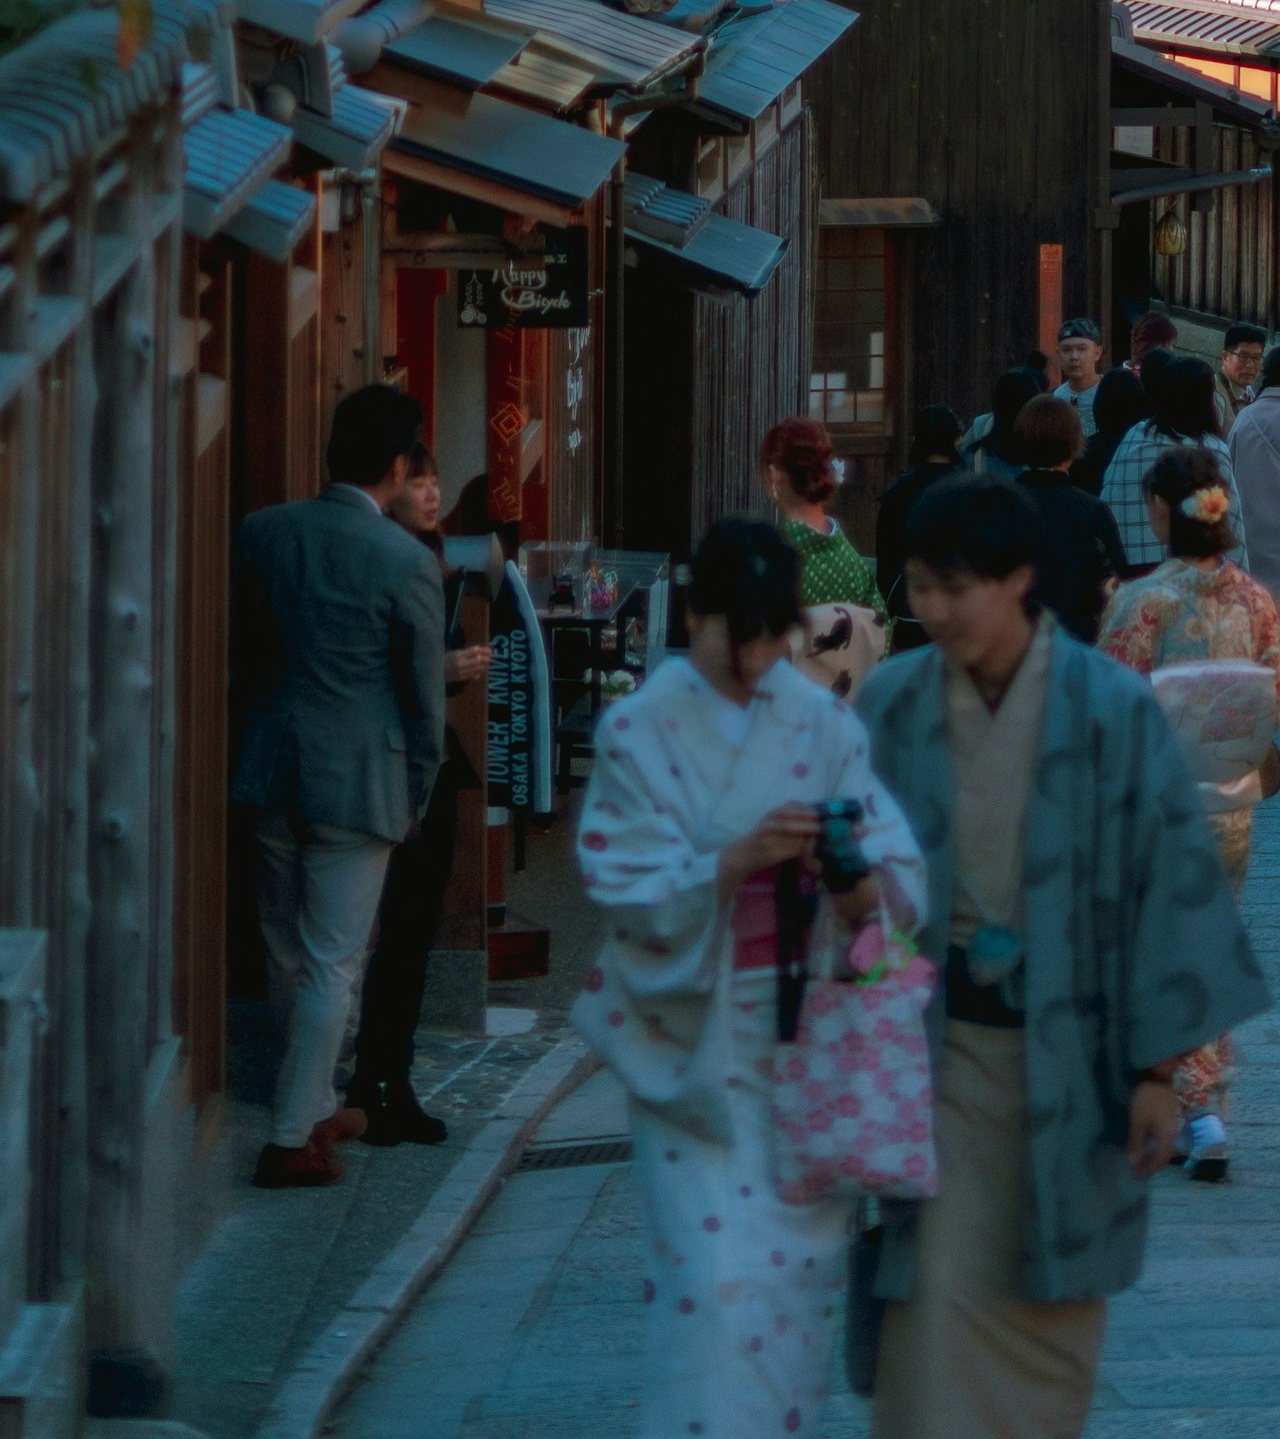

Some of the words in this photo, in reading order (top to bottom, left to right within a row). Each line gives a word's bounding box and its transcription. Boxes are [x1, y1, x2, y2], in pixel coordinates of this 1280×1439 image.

[500, 288, 572, 315] Bicycle
[487, 634, 510, 705] KNIVES
[510, 629, 527, 683] KYOTO
[510, 690, 528, 744] TOKYO
[511, 751, 529, 806] OSAKA
